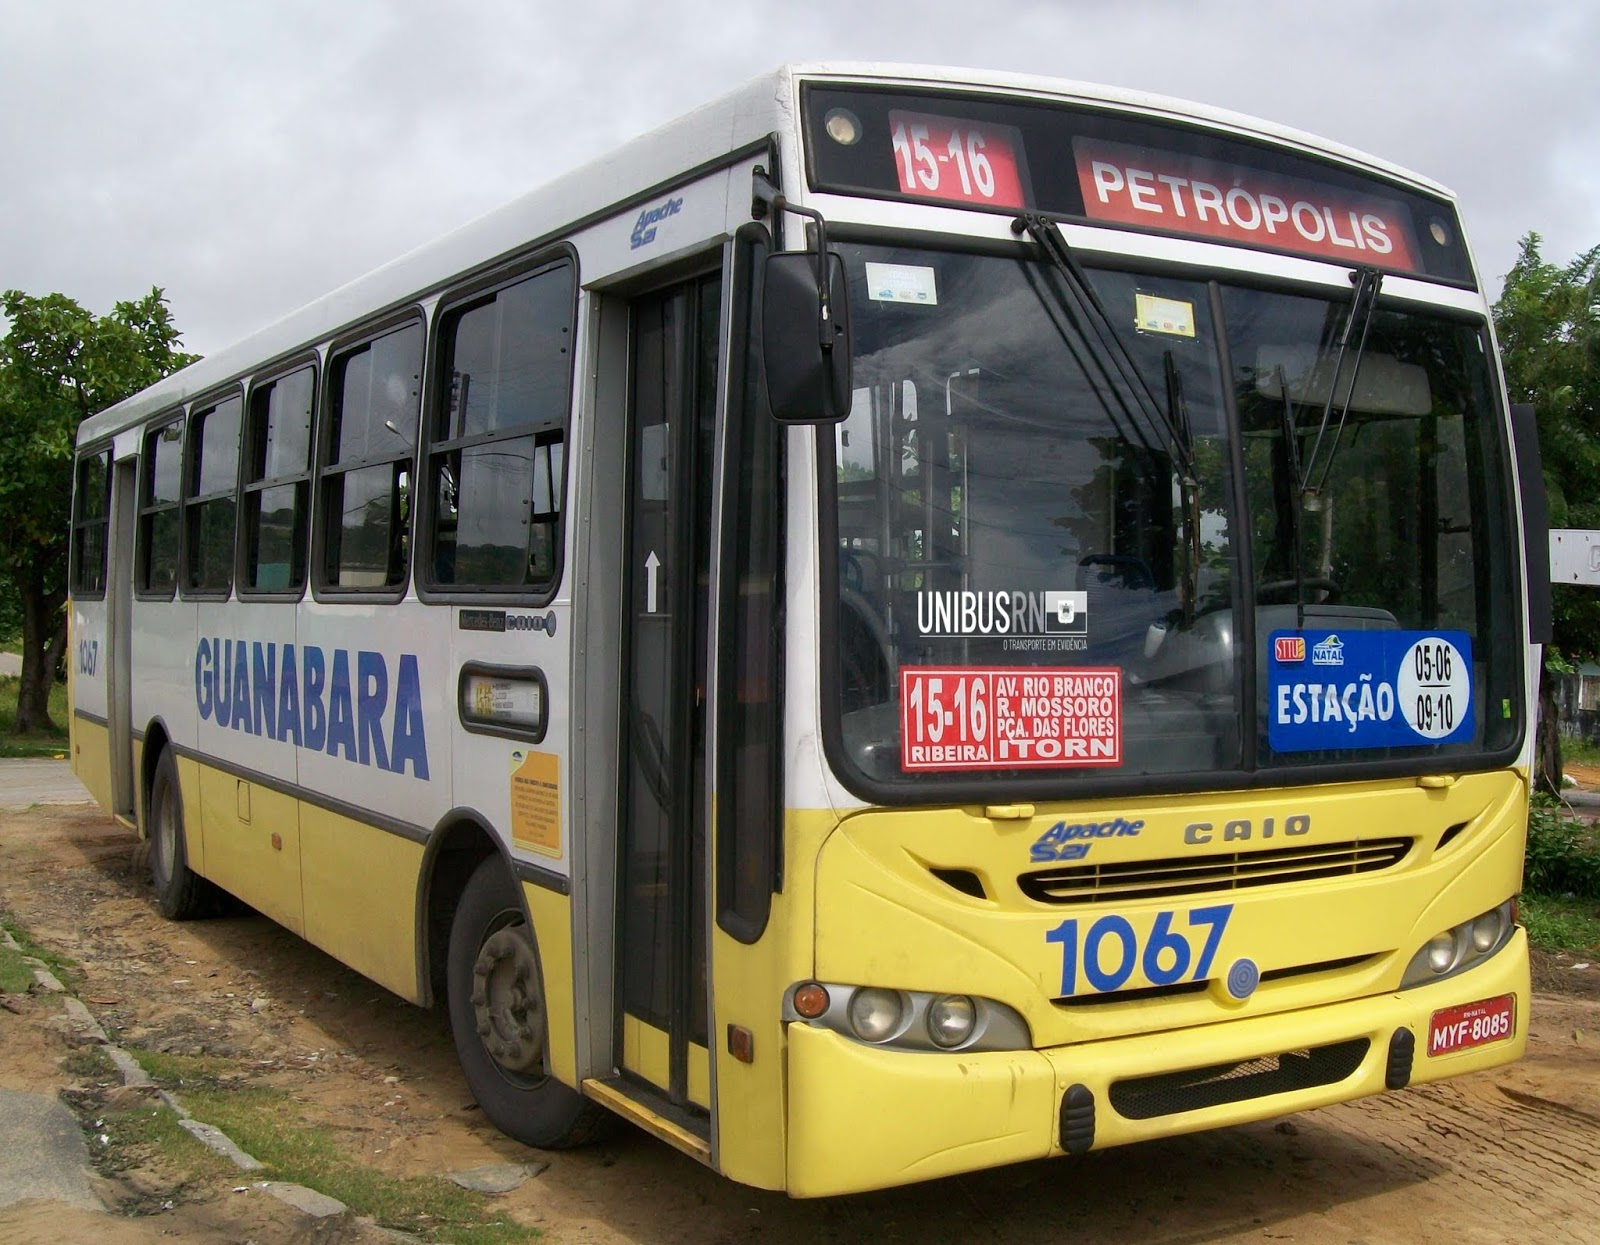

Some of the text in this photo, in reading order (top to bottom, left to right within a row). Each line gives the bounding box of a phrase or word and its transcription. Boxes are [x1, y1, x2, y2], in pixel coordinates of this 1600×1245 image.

[893, 120, 994, 198] 15-16
[633, 197, 684, 233] Apache
[1092, 160, 1393, 255] PETRÓPOLIS
[506, 615, 544, 631] CAIO
[80, 639, 98, 677] 1067
[1276, 639, 1299, 659] STTU
[1314, 650, 1343, 661] NATAL
[1415, 645, 1451, 682] 05-06
[996, 677, 1114, 697] AV. RIO BRANCO
[1277, 673, 1395, 732] ESTAÇÃO
[195, 637, 430, 781] GUANABARA
[910, 677, 988, 743] 15-16
[997, 698, 1016, 717] R.
[1416, 693, 1453, 731] 09-10
[1033, 718, 1060, 738] DAS
[1063, 717, 1115, 737] FLORES
[911, 745, 989, 762] RIBEIRA
[999, 738, 1114, 758] ITORN
[1037, 817, 1146, 845] Apache
[1183, 814, 1311, 845] CAIO
[1045, 903, 1234, 996] 1067
